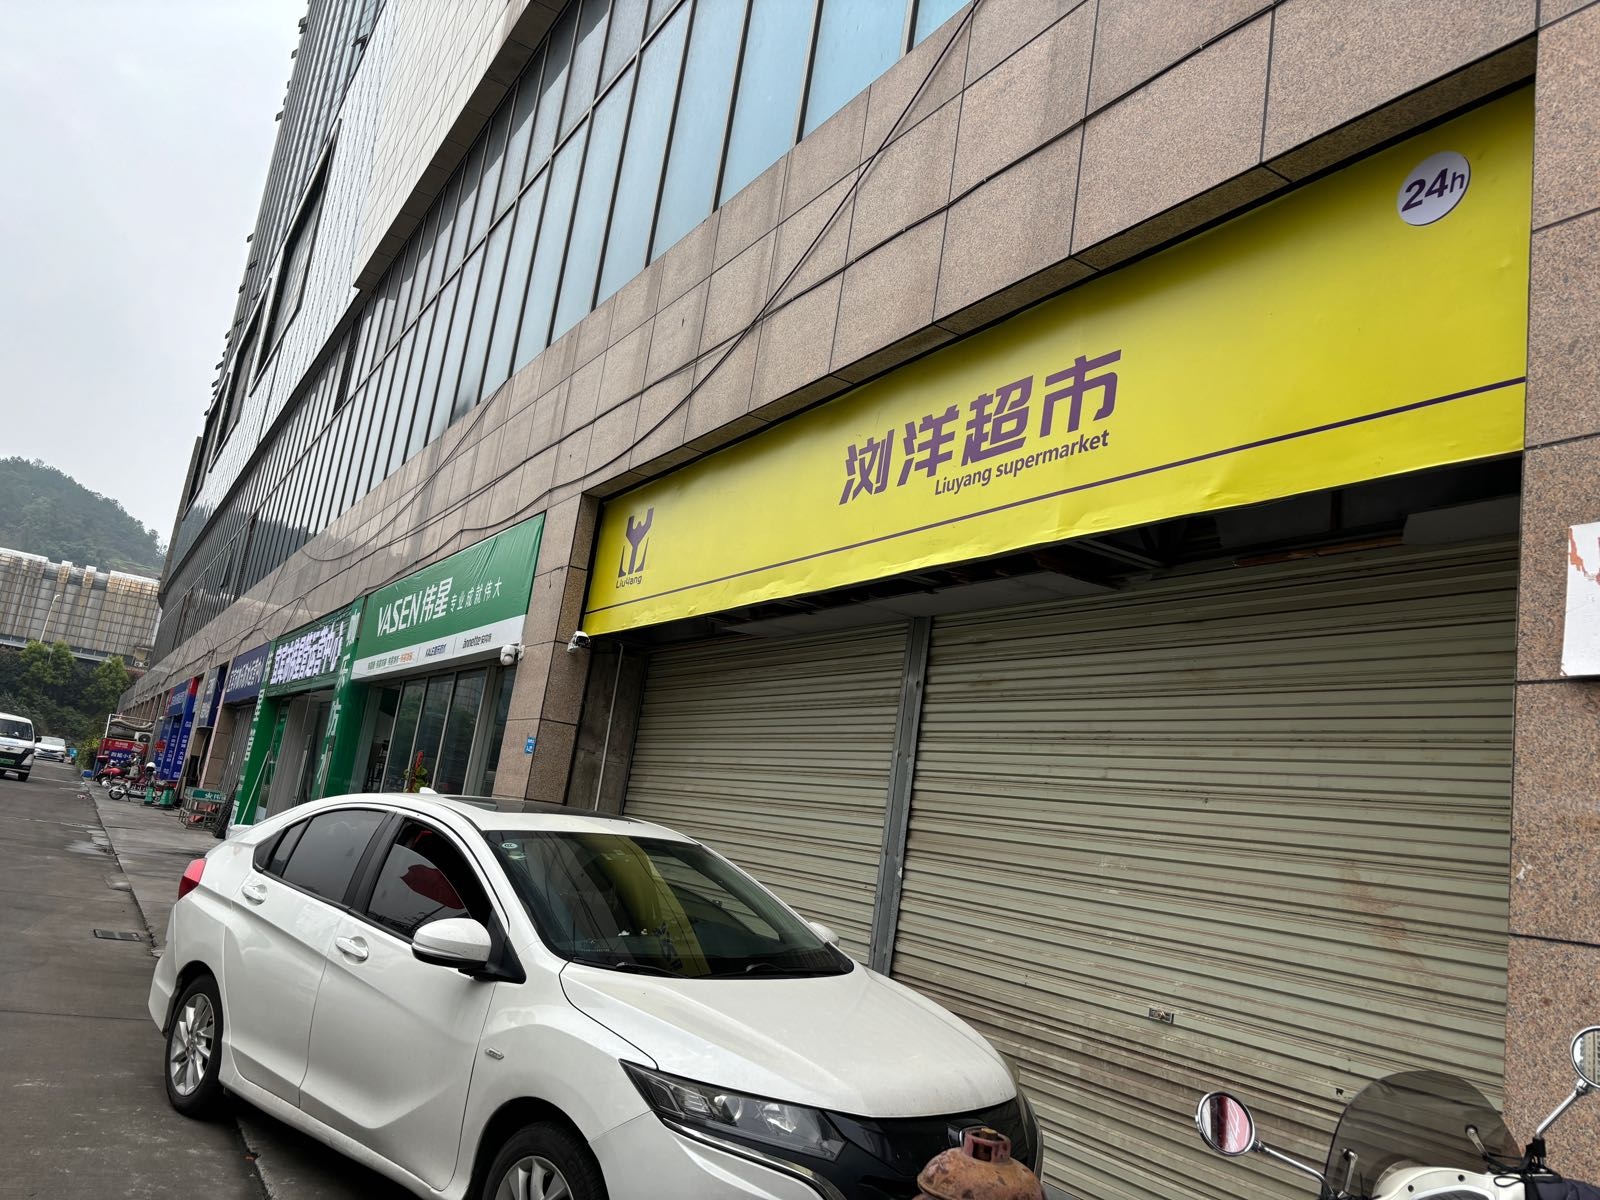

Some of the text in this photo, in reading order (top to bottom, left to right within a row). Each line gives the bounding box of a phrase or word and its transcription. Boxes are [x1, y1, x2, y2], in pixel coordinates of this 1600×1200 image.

[1401, 168, 1466, 212] 24h
[839, 349, 1122, 506] 浏洋超市
[934, 429, 1110, 496] Liuyang supermarket
[450, 576, 503, 613] 专业成就伟大
